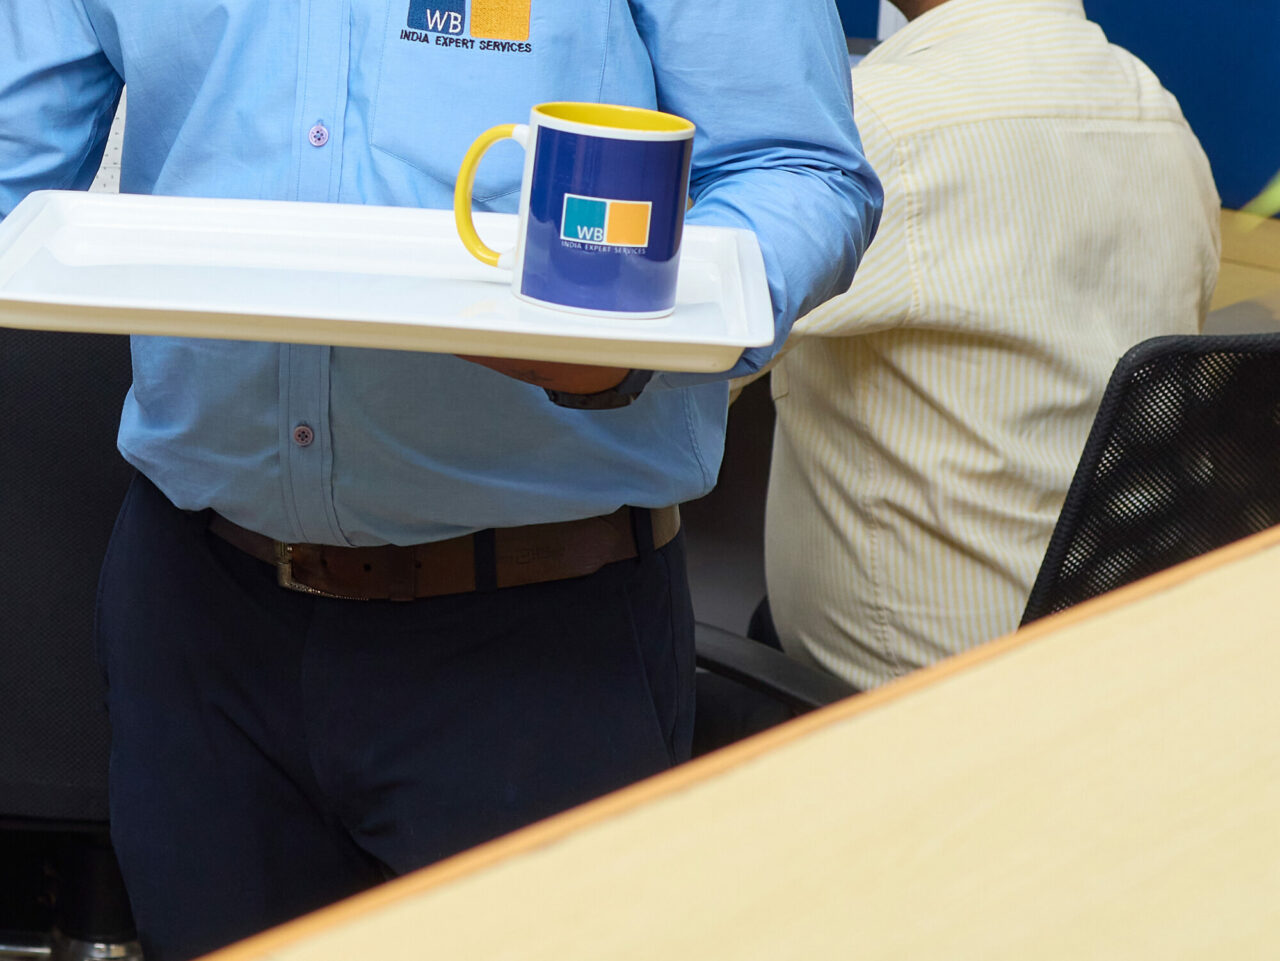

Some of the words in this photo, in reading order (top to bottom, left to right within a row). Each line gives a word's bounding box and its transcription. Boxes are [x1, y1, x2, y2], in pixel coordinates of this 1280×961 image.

[425, 7, 463, 34] WB
[399, 28, 430, 45] INDIA
[434, 35, 475, 50] EXPERT
[479, 39, 533, 54] SERVICES
[577, 224, 604, 242] WB
